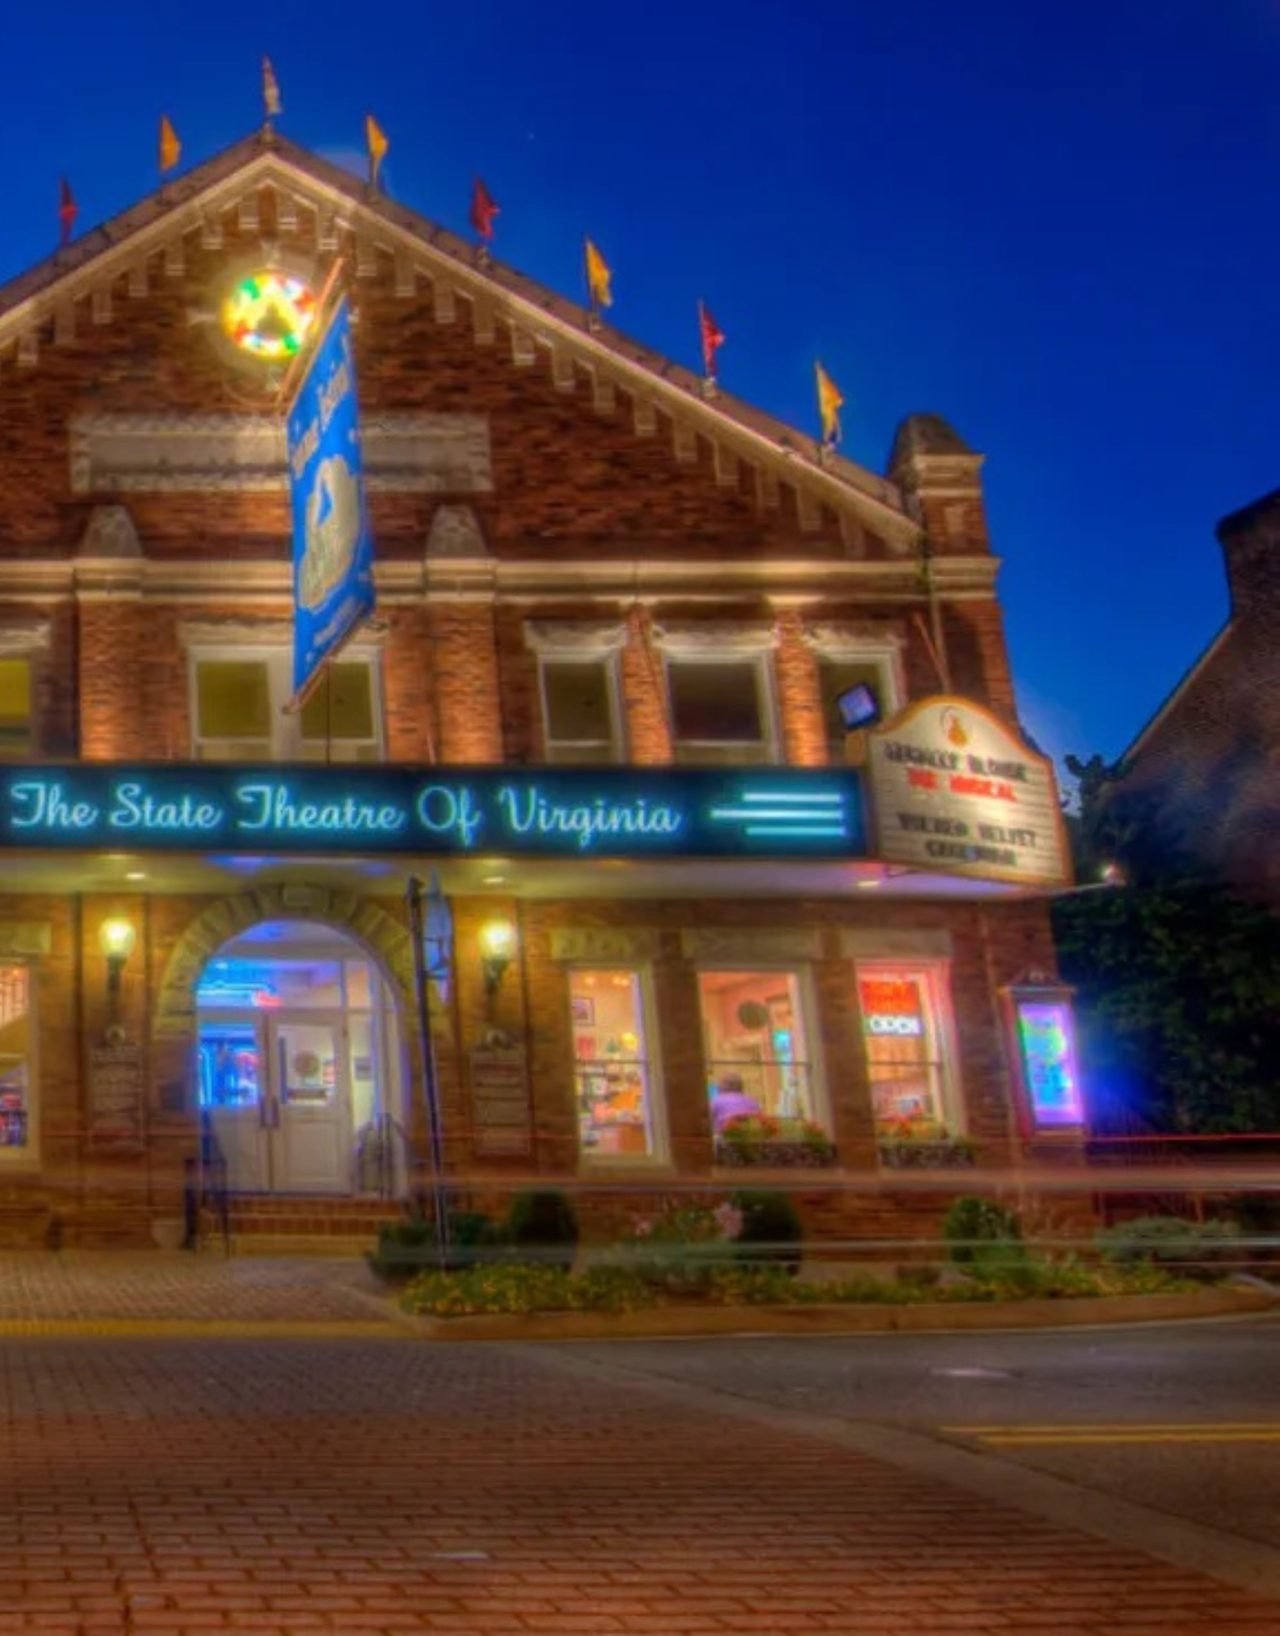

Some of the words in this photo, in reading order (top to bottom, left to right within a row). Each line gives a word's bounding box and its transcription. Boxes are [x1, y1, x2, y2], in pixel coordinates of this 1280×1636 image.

[9, 781, 99, 828] The
[109, 782, 224, 828] State
[236, 784, 407, 830] Theatre
[417, 784, 483, 847] Of
[497, 785, 683, 847] Virginia
